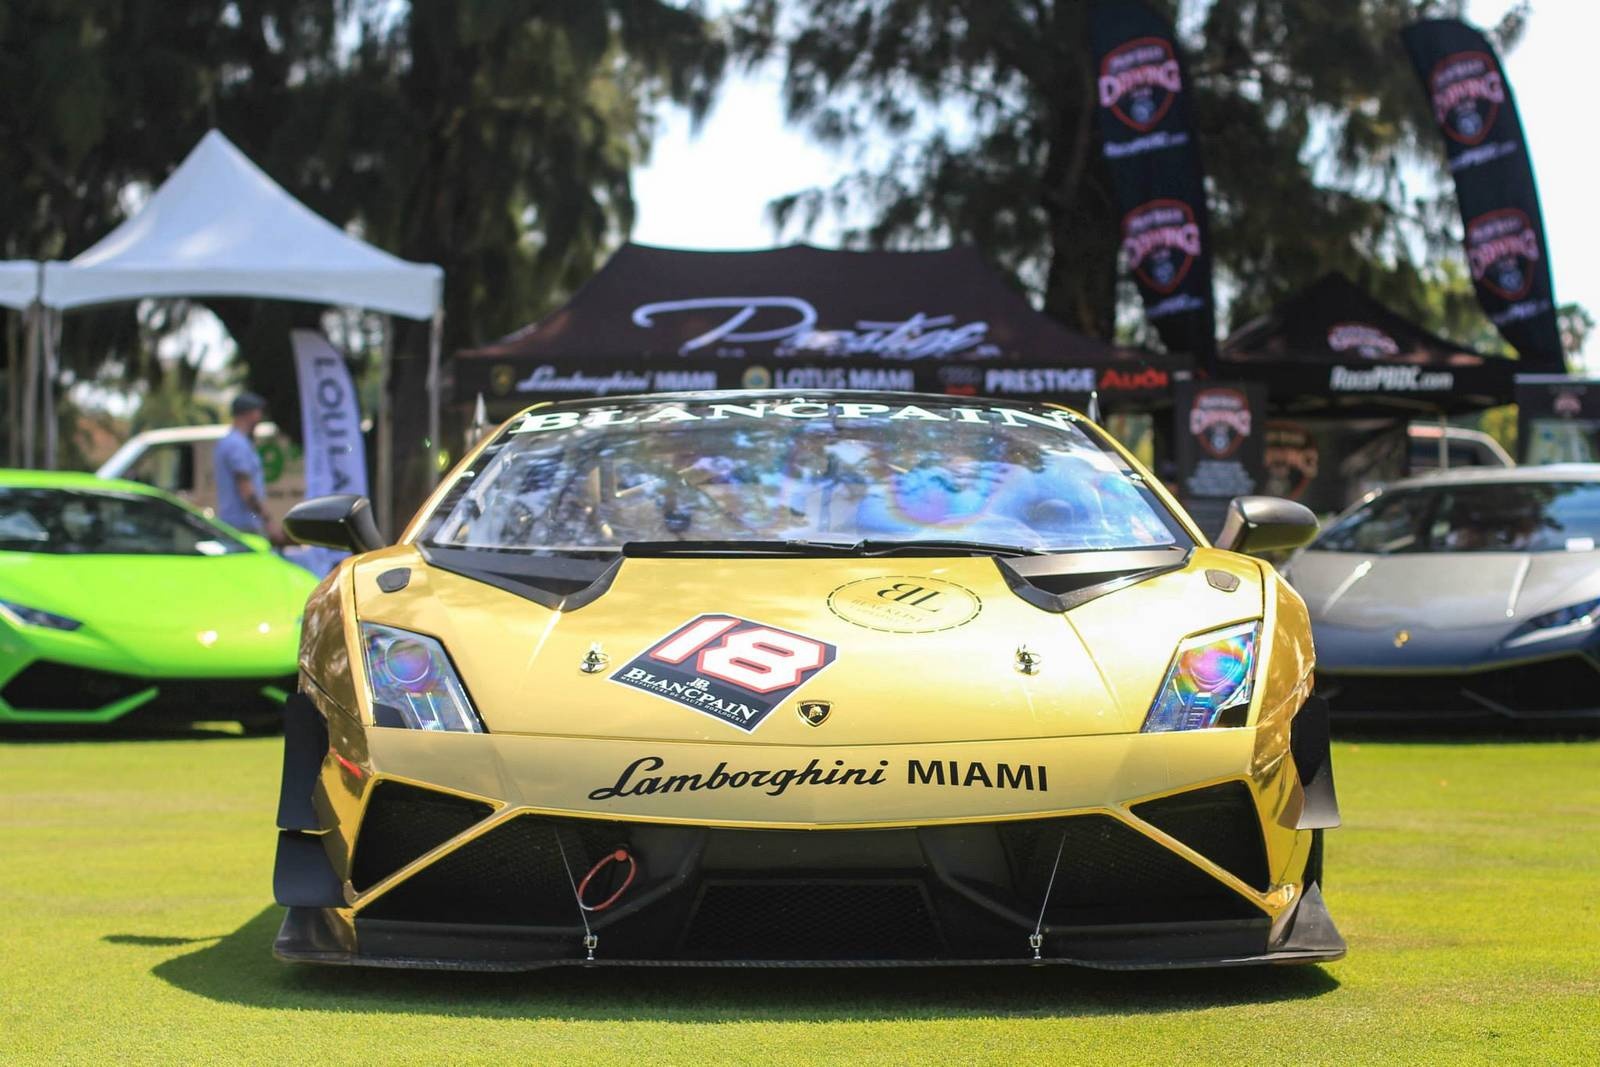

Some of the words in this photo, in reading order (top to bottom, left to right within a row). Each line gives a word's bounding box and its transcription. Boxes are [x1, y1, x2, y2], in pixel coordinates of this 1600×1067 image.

[775, 368, 845, 389] LOTUS
[985, 369, 1095, 392] PRESTIGE
[508, 401, 1072, 434] BLANCPAIN
[650, 618, 825, 694] 18
[622, 667, 759, 721] BLANCPAIN
[681, 695, 704, 707] HAUTE
[588, 756, 889, 801] Lamborghini
[906, 759, 1049, 792] MIAMI
